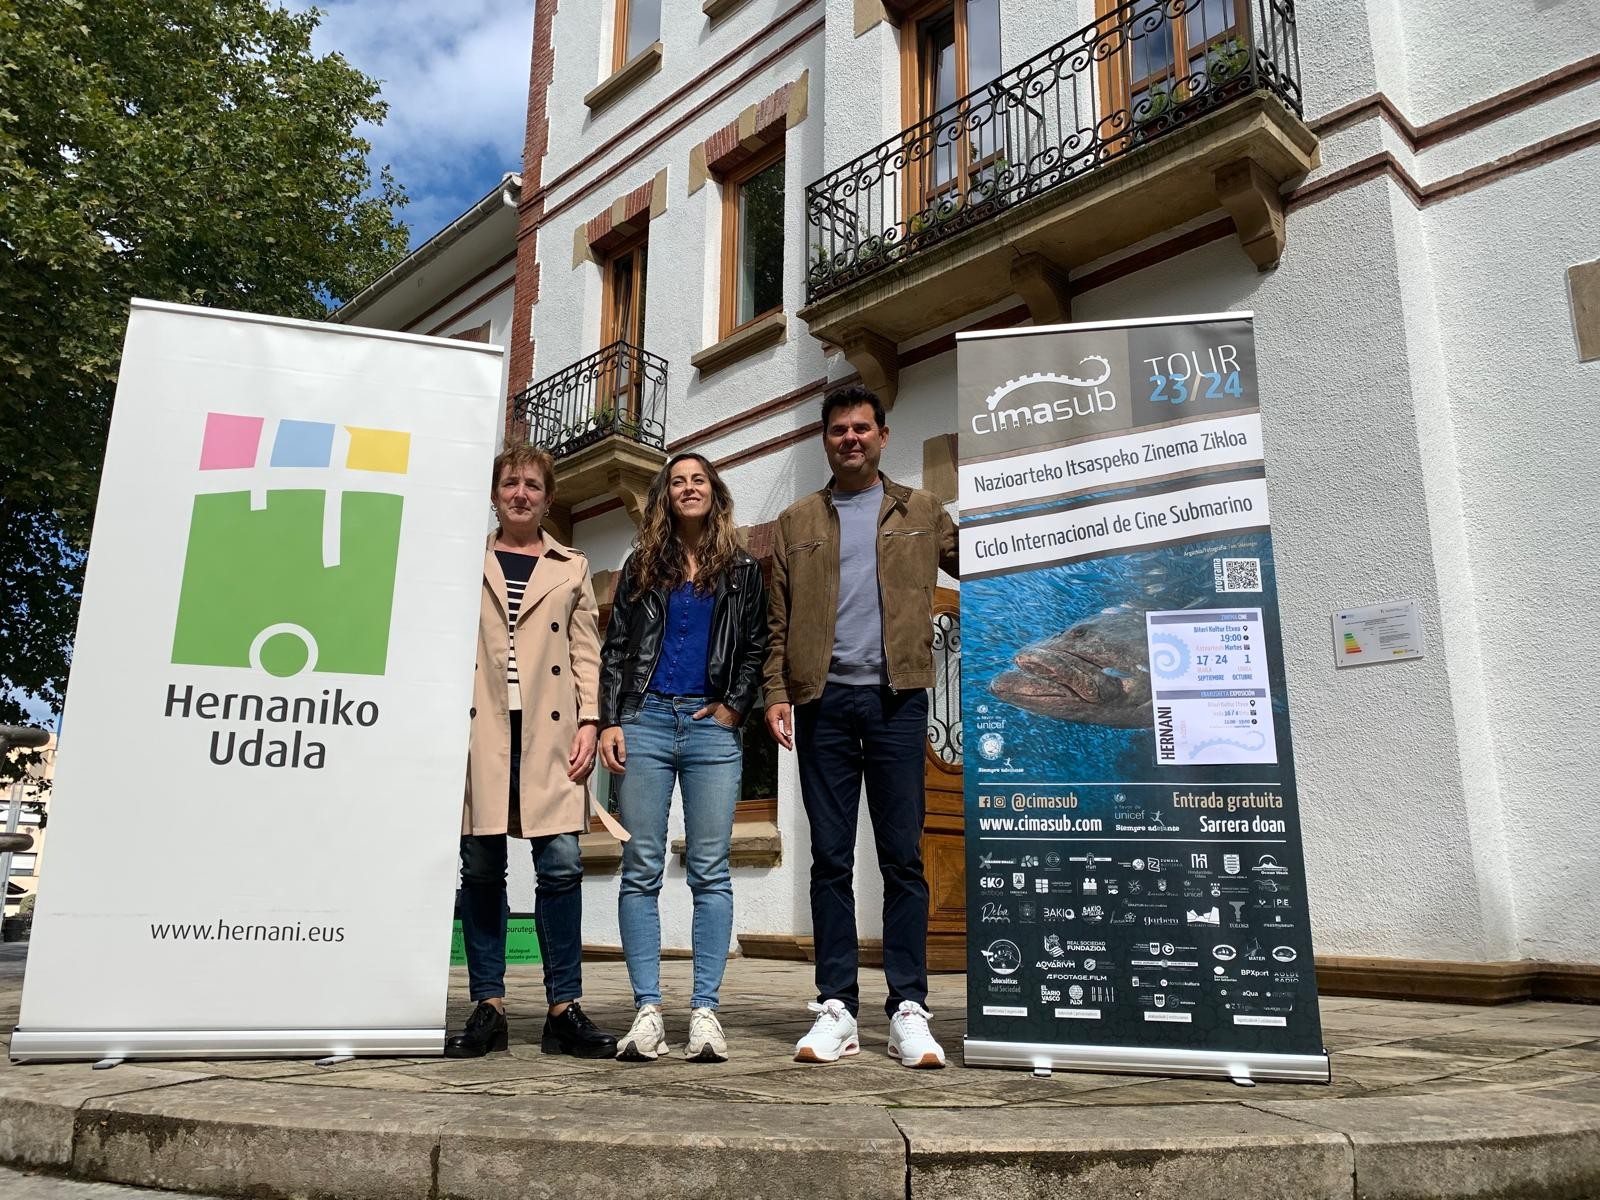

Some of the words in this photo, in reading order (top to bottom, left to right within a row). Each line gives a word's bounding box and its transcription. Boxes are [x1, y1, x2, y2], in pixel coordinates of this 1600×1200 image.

[1144, 345, 1241, 385] TOUR
[972, 387, 1116, 435] cimasub
[974, 464, 1063, 493] Nazioarteko
[1066, 449, 1140, 476] Itsaspeko
[1142, 438, 1198, 463] Zinema
[1200, 430, 1248, 449] Zikloa
[975, 533, 1008, 559] Ciclo
[1012, 517, 1109, 552] Internacional
[1113, 514, 1132, 534] de
[1135, 510, 1167, 532] Cine
[1170, 496, 1253, 524] Submarino
[1220, 634, 1242, 643] 19:00
[1196, 655, 1209, 666] 17
[1215, 654, 1228, 664] 24
[1244, 654, 1251, 664] 1
[164, 683, 379, 729] Hernaniko
[976, 719, 1006, 729] unicef
[1157, 706, 1175, 760] HERNANI
[208, 729, 327, 771] Udala
[1011, 792, 1078, 812] @cimasub
[1173, 792, 1224, 809] Entrada
[1227, 793, 1283, 812] gratuita
[979, 814, 1102, 832] www.cimasub.com
[1114, 810, 1145, 820] unicef
[1200, 815, 1249, 833] Sarrera
[1252, 815, 1286, 833] doan
[1115, 824, 1146, 833] Siempre
[150, 918, 346, 945] www.hernani.eus
[999, 985, 1021, 993] Sociedad
